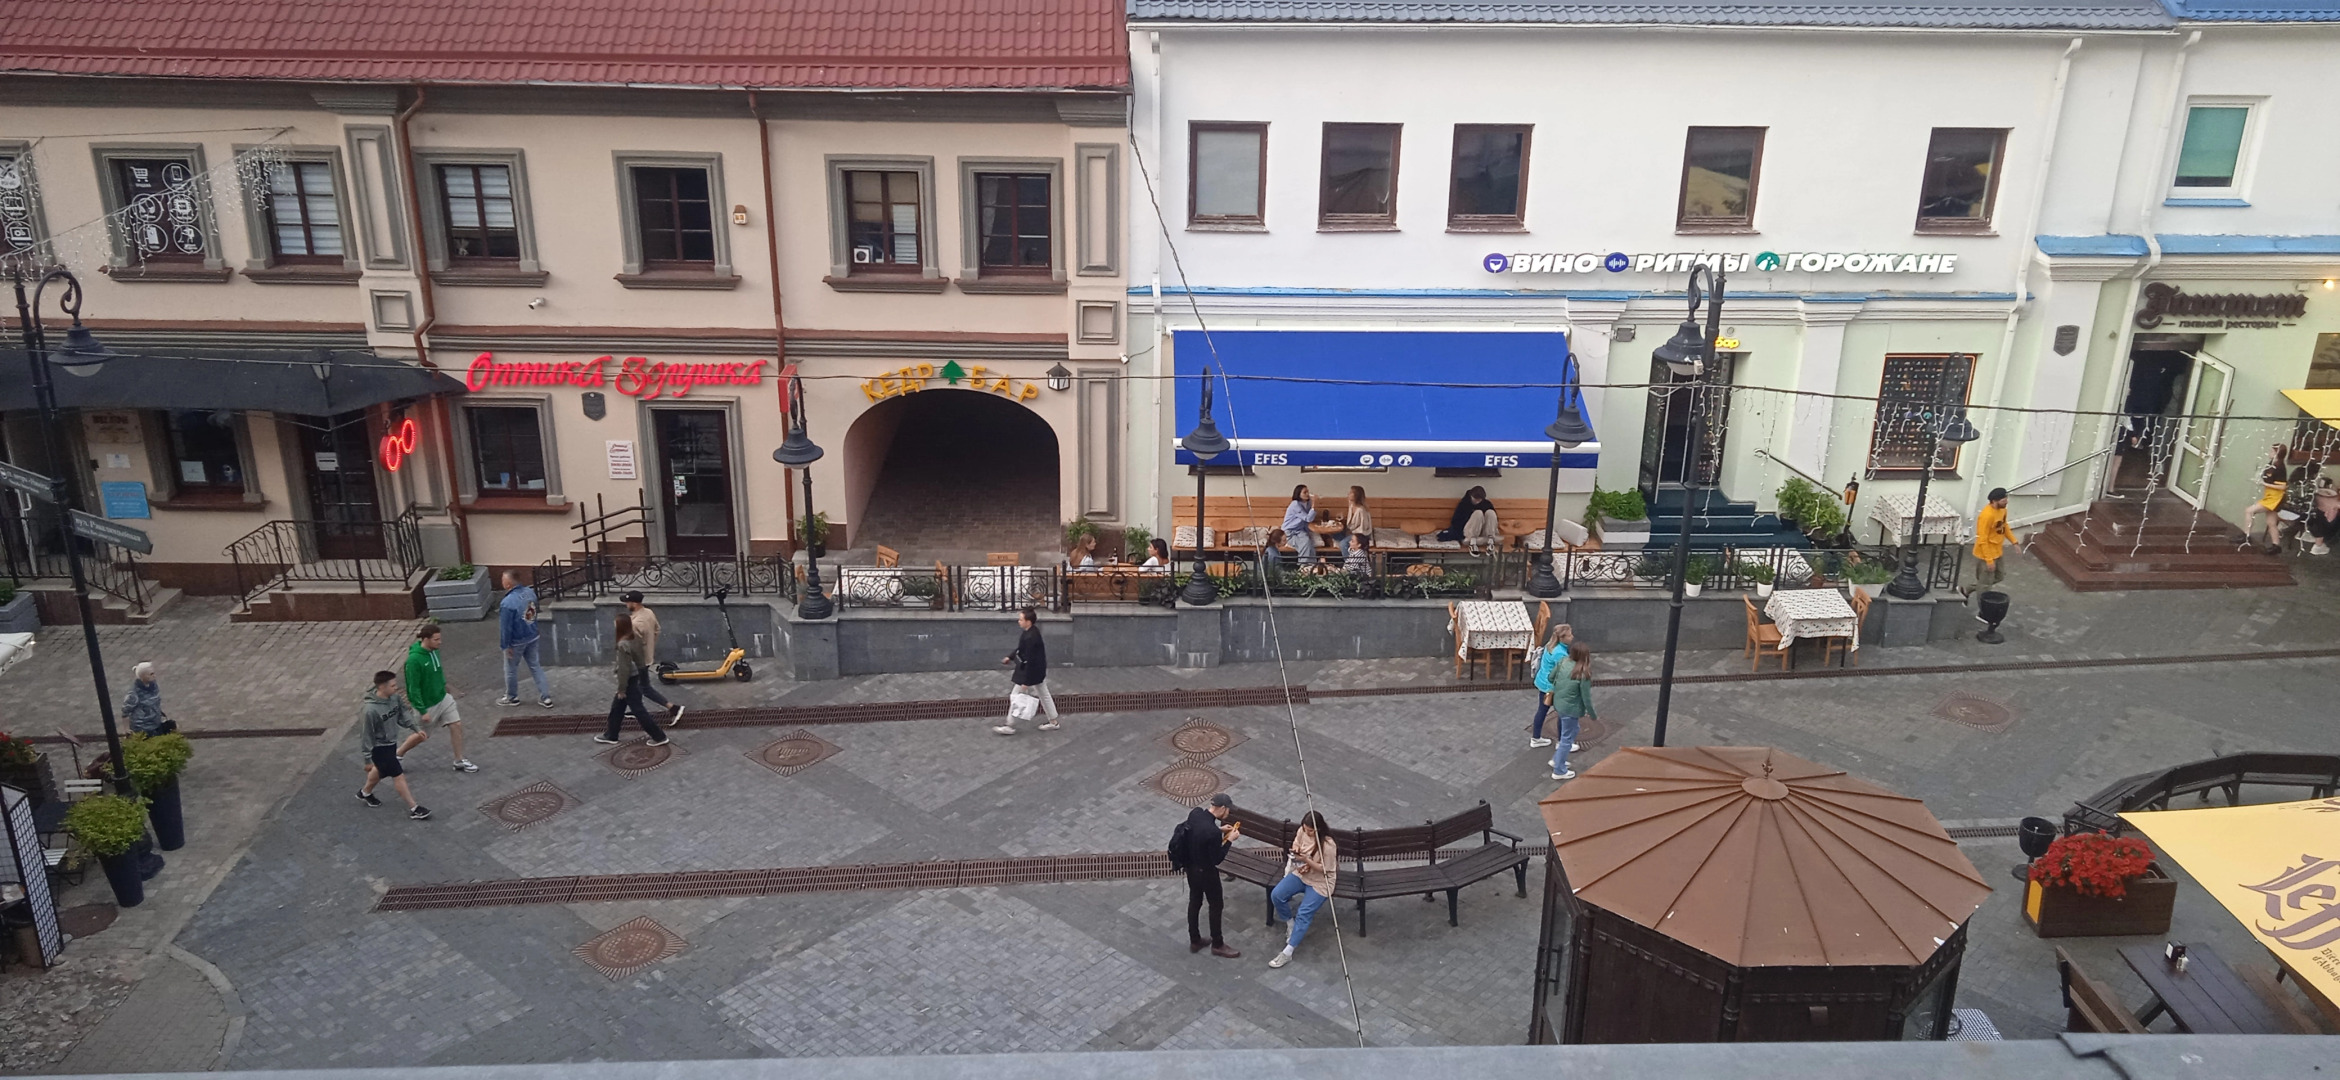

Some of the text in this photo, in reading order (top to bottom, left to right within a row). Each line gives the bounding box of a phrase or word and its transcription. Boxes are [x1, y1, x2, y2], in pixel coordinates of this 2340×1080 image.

[1511, 253, 1958, 275] ВИНО РИТМЫ ГОРОЖАНЕ
[2225, 320, 2279, 330] ресторан
[1715, 336, 1740, 349] бар
[466, 351, 612, 391] Оптика
[860, 362, 1039, 403] КЕДР БАР
[1254, 453, 1288, 466] EFES
[1484, 454, 1519, 467] EFES
